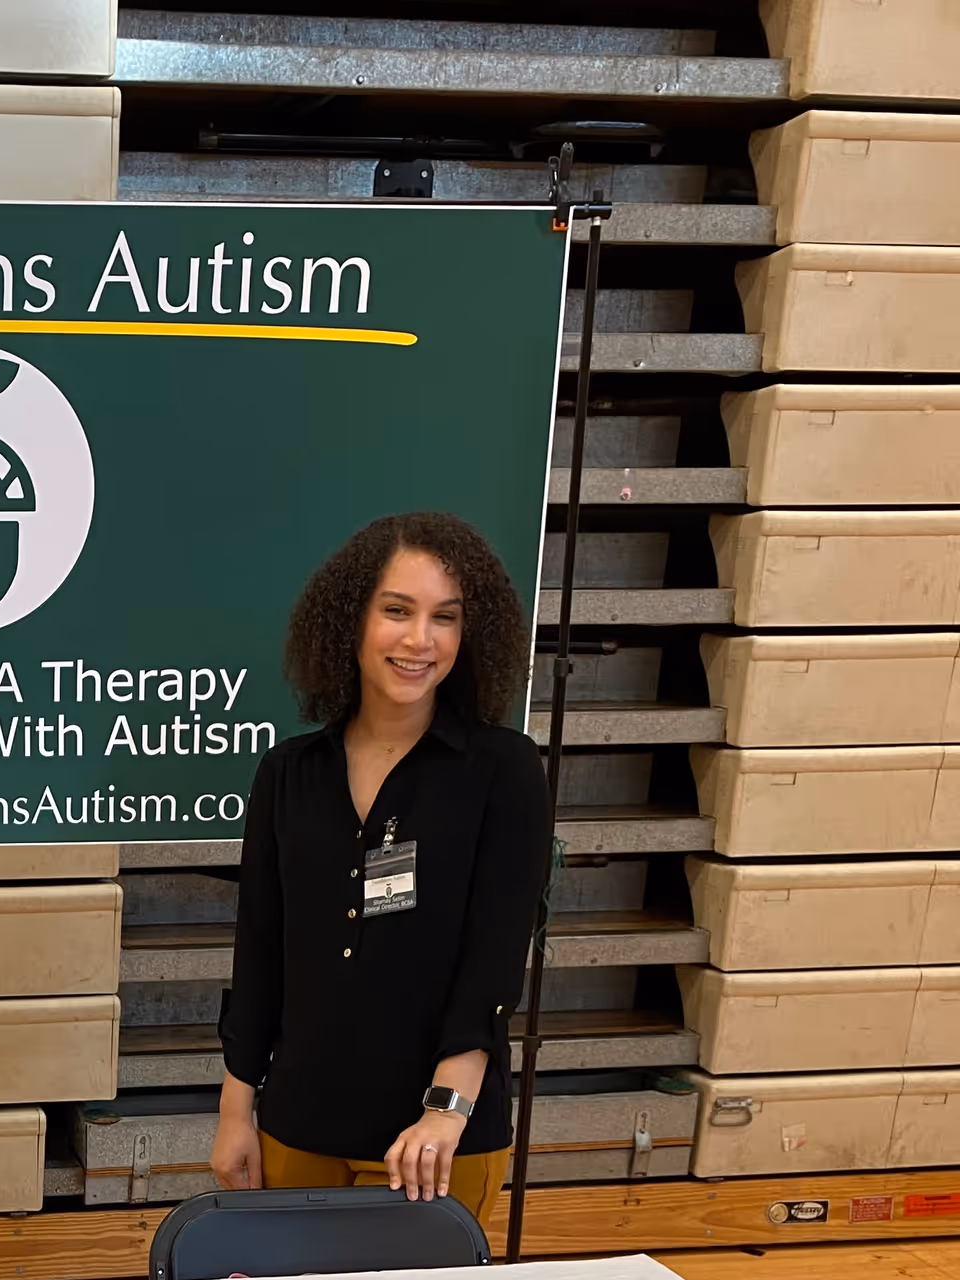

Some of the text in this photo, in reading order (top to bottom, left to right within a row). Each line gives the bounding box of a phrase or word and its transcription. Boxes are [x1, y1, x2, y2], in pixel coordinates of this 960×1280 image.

[87, 230, 372, 316] Autism
[41, 659, 248, 712] Therapy
[104, 713, 276, 757] Autism
